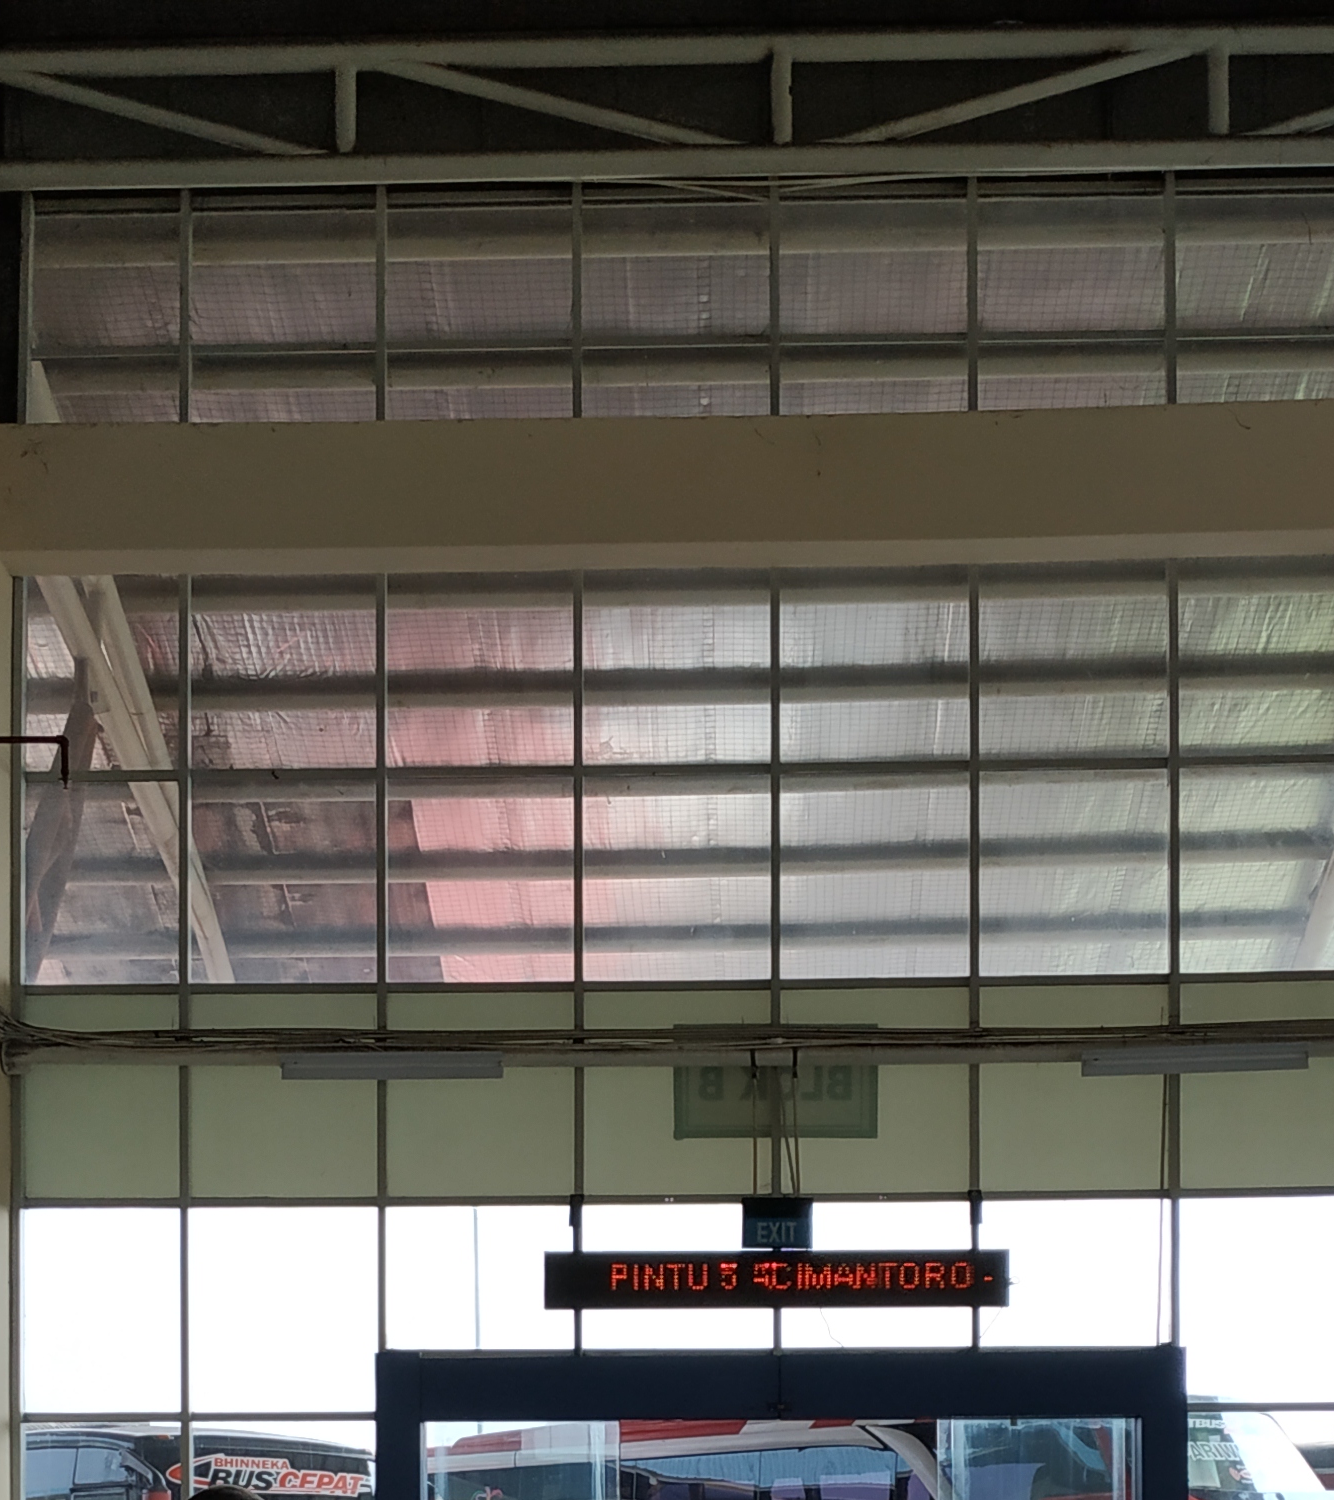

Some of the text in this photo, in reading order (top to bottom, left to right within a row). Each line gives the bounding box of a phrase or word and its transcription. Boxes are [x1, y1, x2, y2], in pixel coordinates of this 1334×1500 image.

[757, 1221, 797, 1243] EXIT
[610, 1262, 709, 1291] PINTU
[214, 1457, 289, 1470] BHINNEKA
